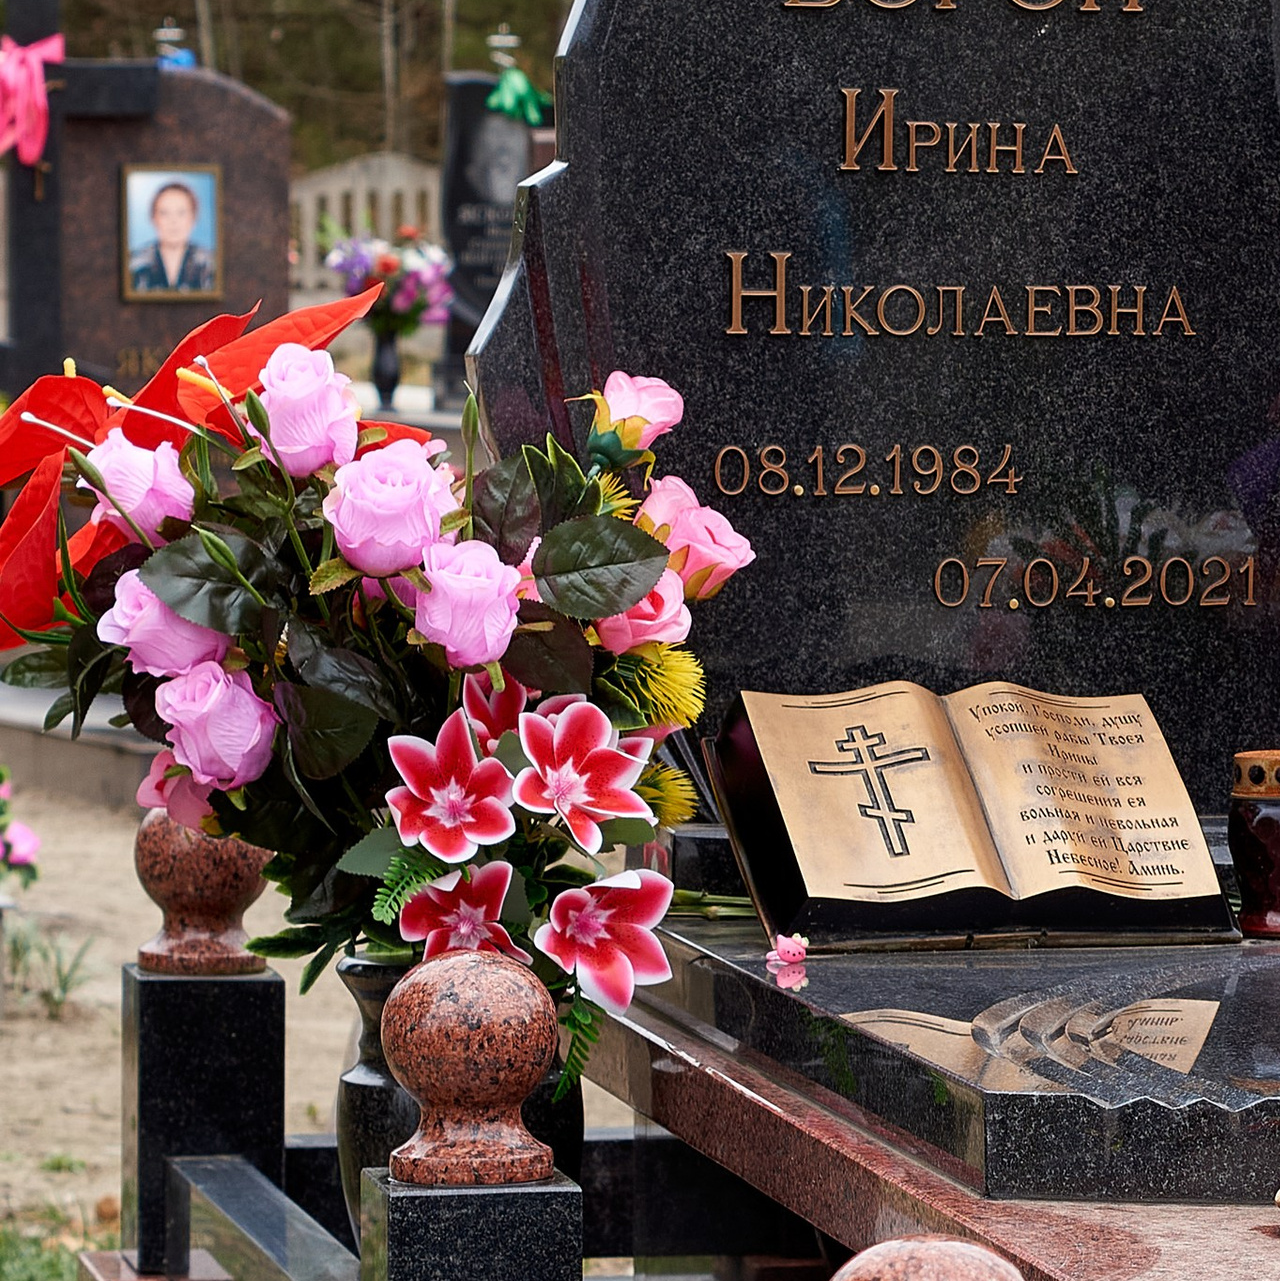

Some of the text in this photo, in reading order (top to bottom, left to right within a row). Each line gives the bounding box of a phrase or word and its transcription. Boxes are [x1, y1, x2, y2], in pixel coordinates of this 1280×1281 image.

[714, 444, 1023, 496] 08.12.1984
[934, 555, 1258, 610] 07.04.2021
[969, 701, 1143, 729] Упокой, Господи, душу
[985, 722, 1050, 741] усопшей
[1054, 730, 1090, 746] рабы
[1046, 743, 1099, 766] Ирины
[1022, 764, 1143, 787] и прости ей вся
[1036, 784, 1146, 808] согрешения ея
[1019, 807, 1179, 830] вольная и невольная
[1025, 830, 1191, 856] и даруй ей Царствие
[1046, 849, 1185, 877] Небесное! Аминь.
